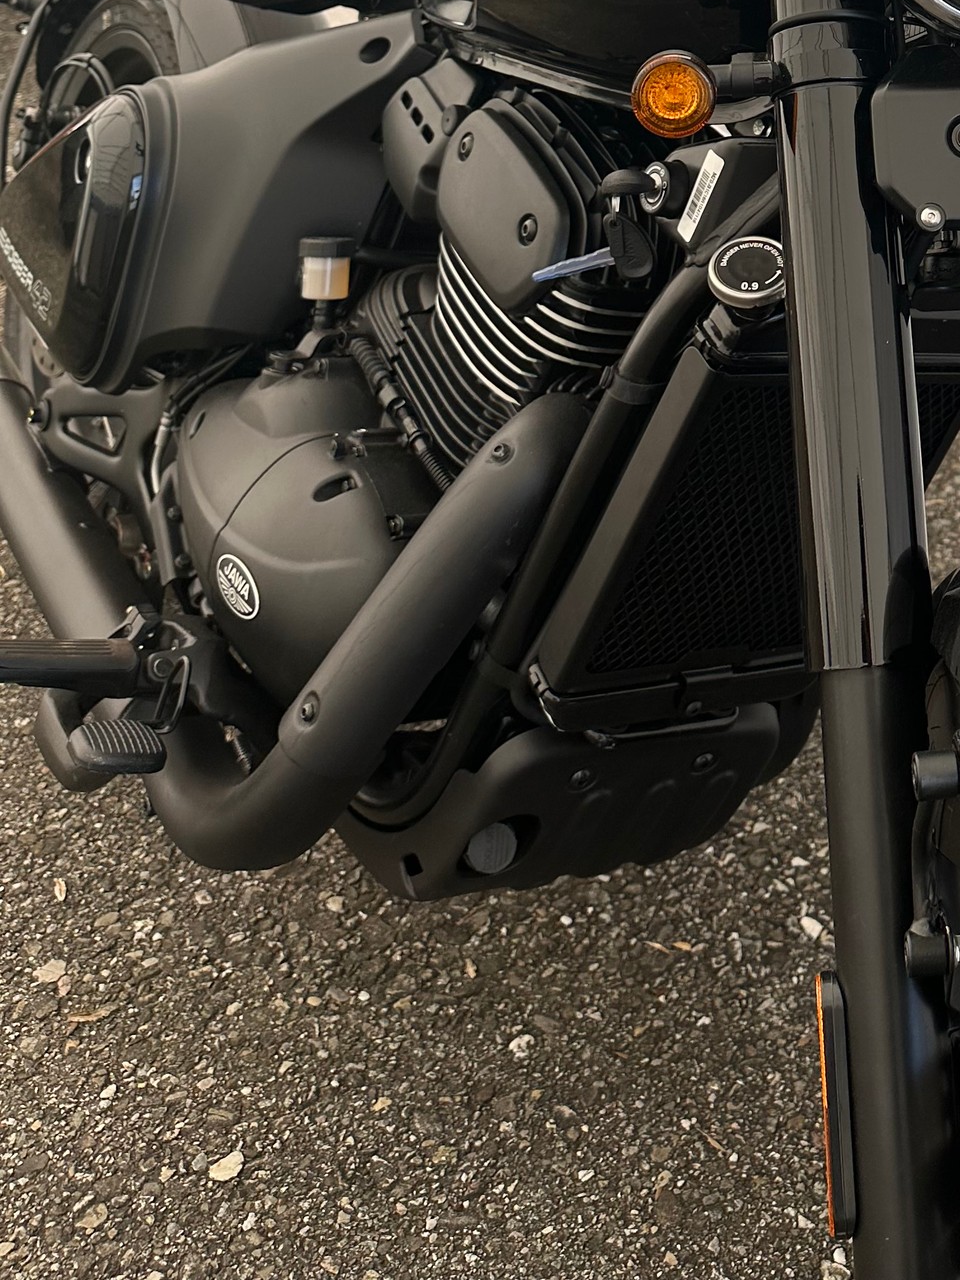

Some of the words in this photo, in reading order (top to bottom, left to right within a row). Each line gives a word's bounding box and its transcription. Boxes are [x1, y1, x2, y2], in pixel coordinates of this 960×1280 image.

[719, 246, 741, 267] DANGER
[739, 242, 763, 250] NEVER
[763, 244, 780, 257] OPEN
[776, 255, 784, 268] HOT
[740, 281, 759, 291] 0.9
[223, 562, 250, 601] JAWA
